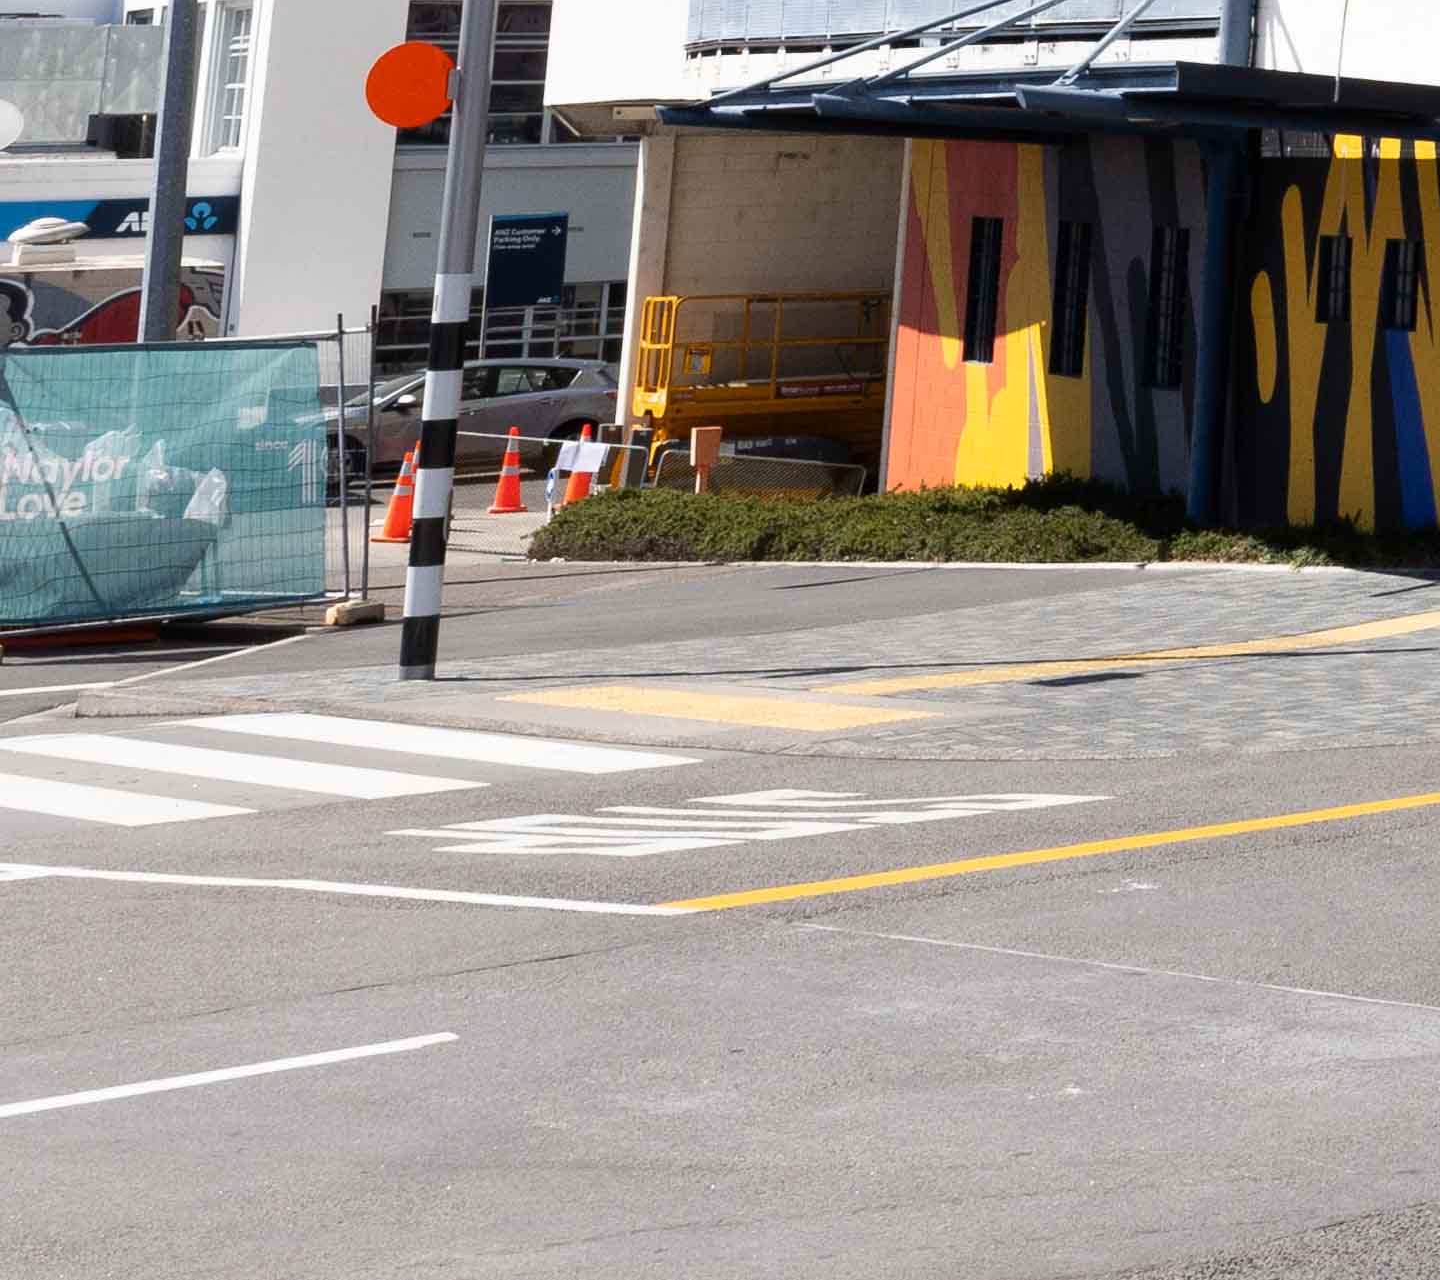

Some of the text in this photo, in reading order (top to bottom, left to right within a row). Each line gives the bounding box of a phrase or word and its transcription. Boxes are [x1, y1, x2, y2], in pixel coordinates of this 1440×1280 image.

[255, 441, 288, 451] since
[2, 447, 130, 495] Naylor
[0, 486, 86, 521] Love
